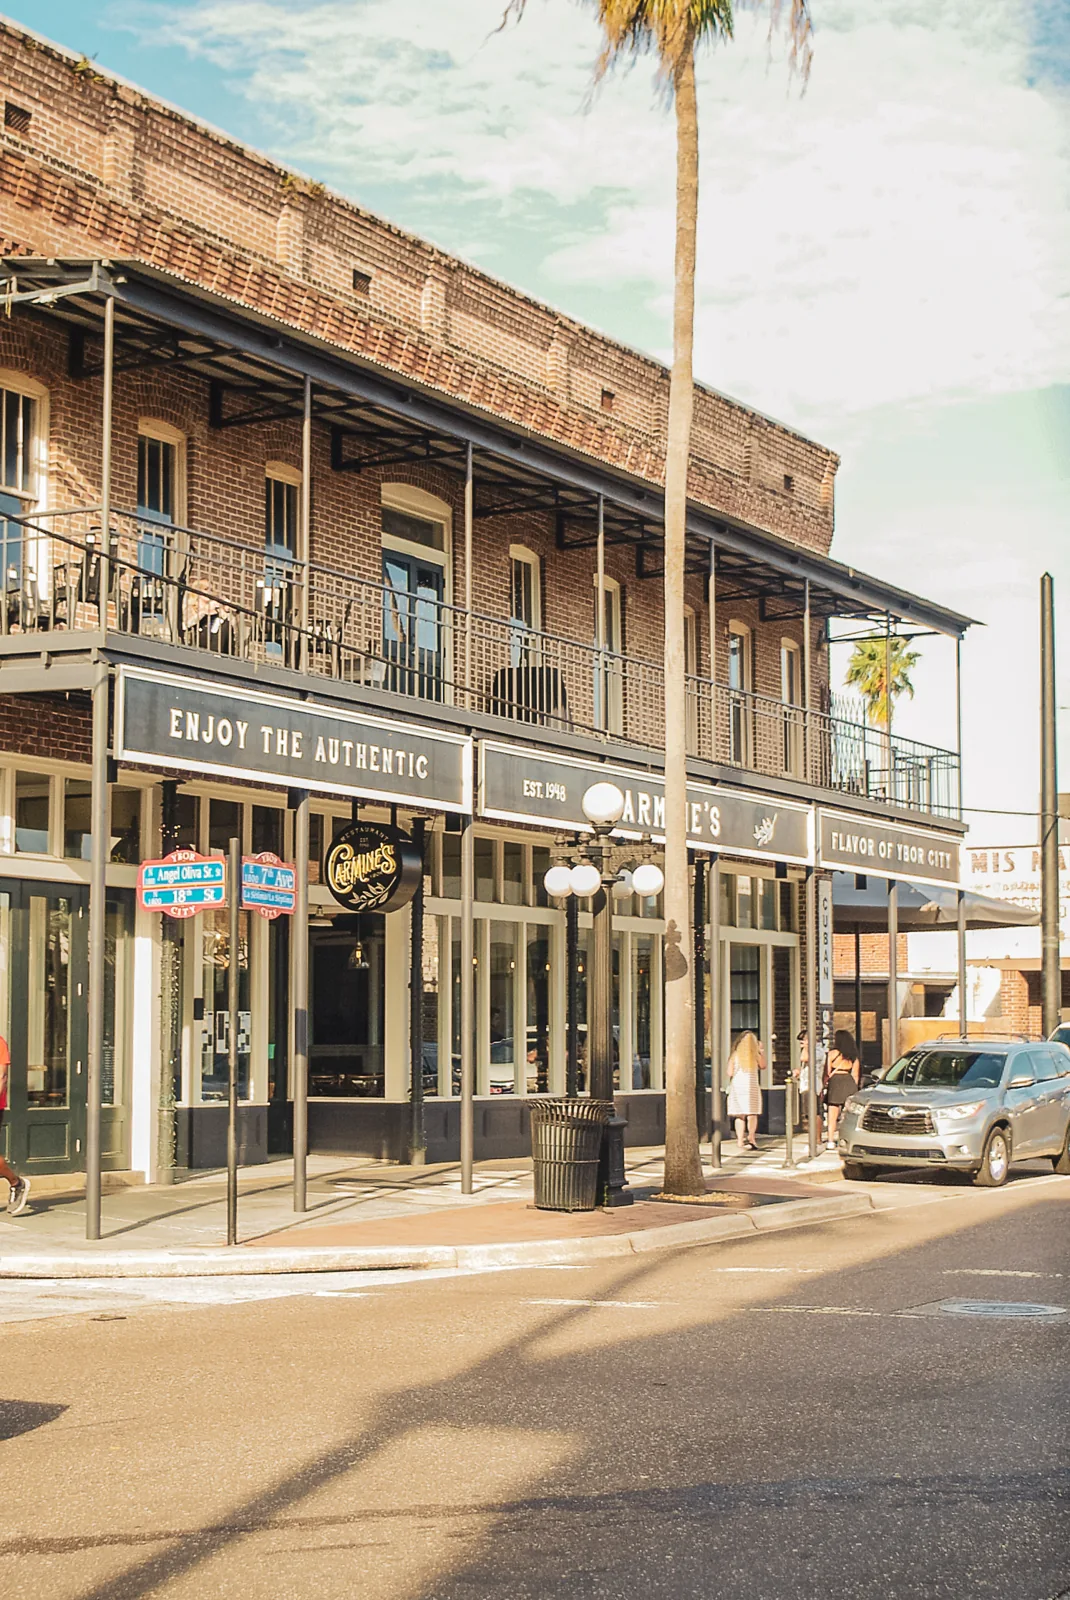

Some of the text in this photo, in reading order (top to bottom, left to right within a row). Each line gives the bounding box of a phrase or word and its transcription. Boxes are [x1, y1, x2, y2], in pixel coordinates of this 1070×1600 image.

[169, 707, 429, 780] ENJOY THE AUTHENTIC
[523, 779, 567, 802] EST. 1948
[340, 826, 389, 842] RESTAURANT
[171, 852, 196, 863] YBOR
[831, 831, 952, 869] FLAVOR OF YBOR CITY
[157, 866, 181, 884] Angel
[181, 866, 202, 880] Oliva
[274, 870, 293, 888] Ave
[203, 888, 216, 901] St
[170, 905, 196, 916] CITY
[260, 906, 278, 917] CITY
[822, 897, 830, 981] CUBAN
